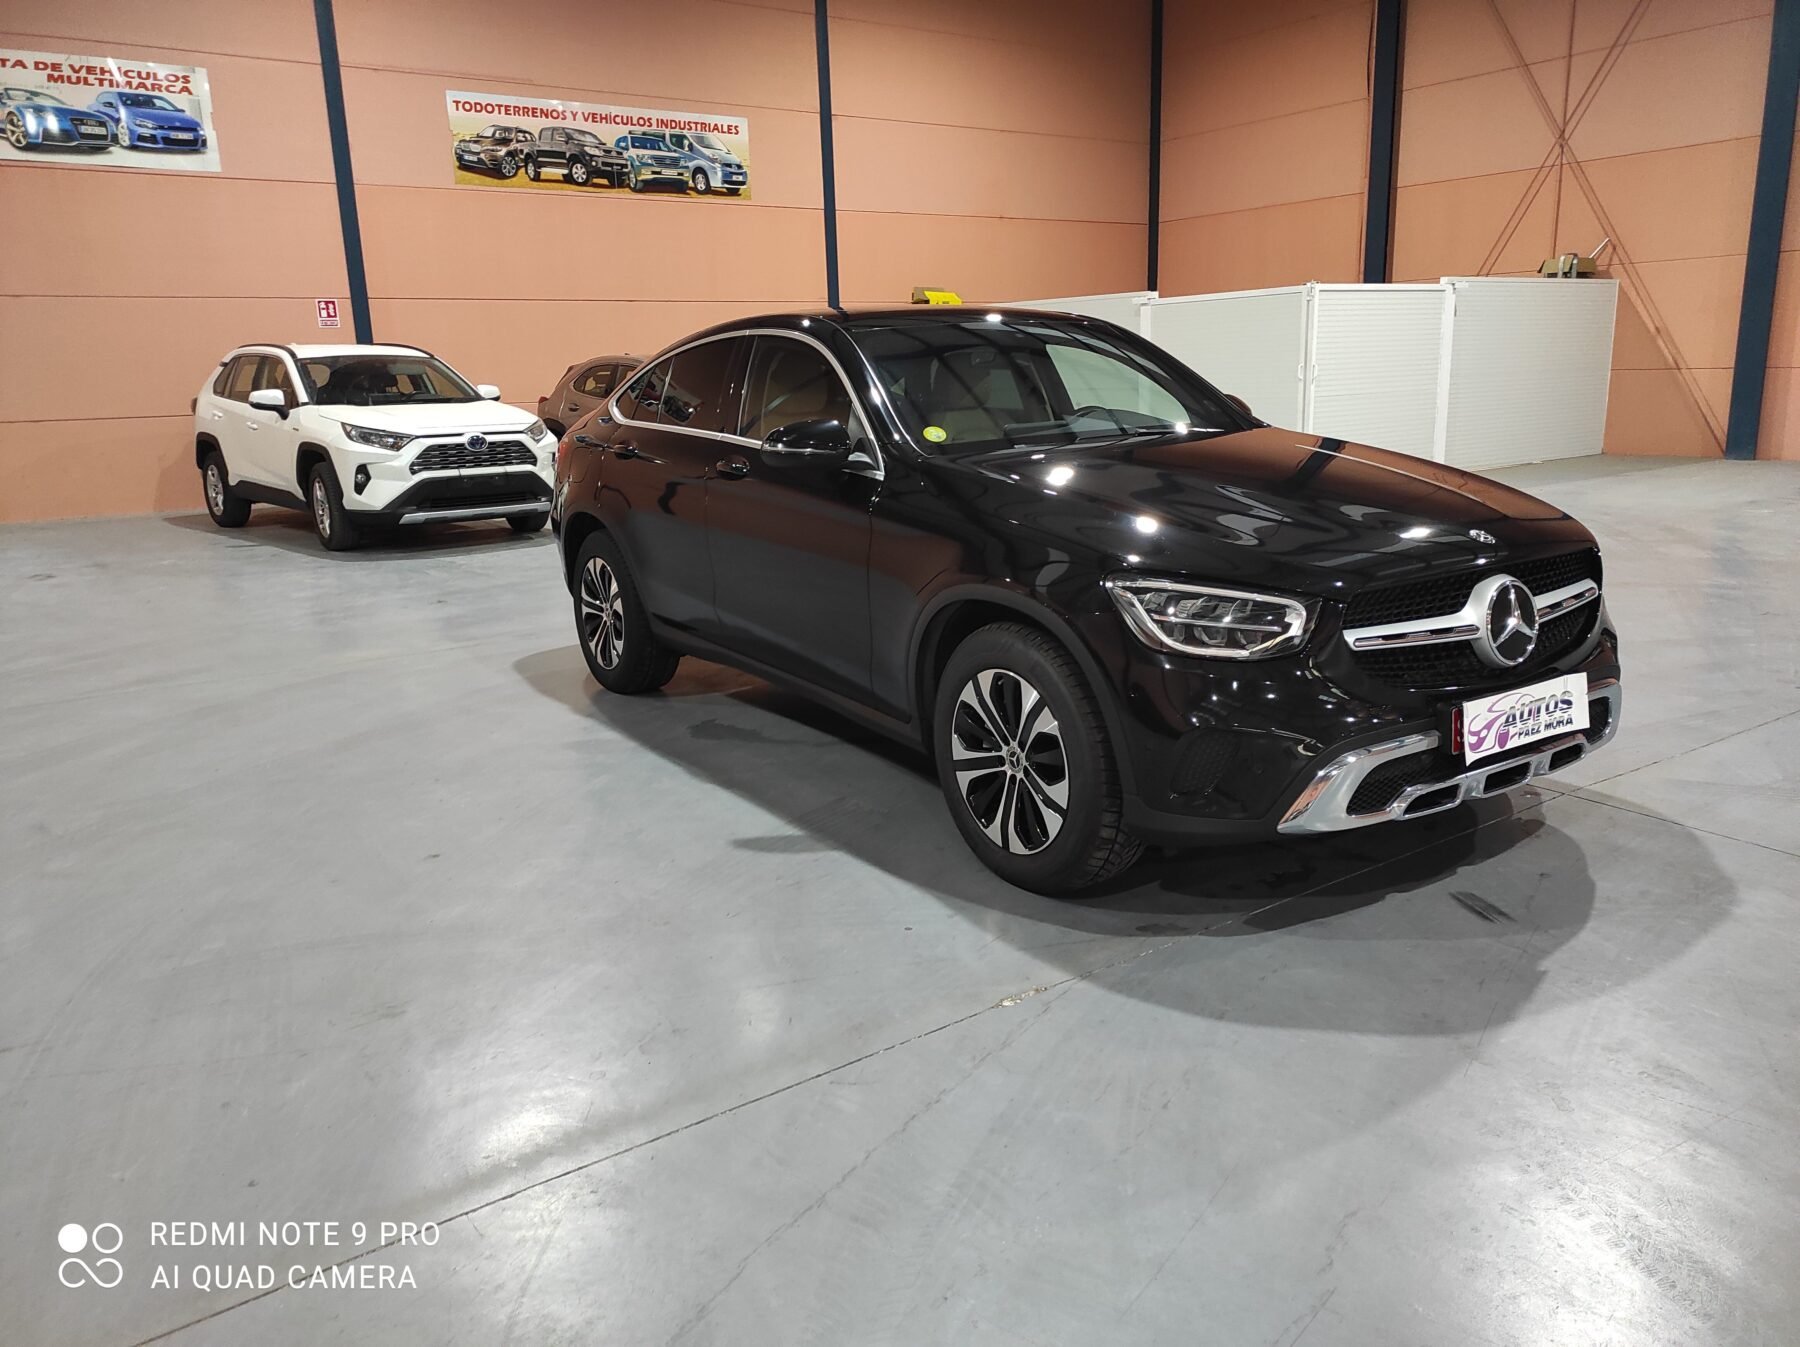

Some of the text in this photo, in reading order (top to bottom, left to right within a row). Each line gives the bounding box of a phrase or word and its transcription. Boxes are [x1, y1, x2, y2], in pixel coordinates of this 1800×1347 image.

[33, 60, 63, 73] DE
[46, 73, 194, 96] MULTIMARCA
[452, 100, 740, 136] TODOTERRENOS Y VEHÍCULOS INDUSTRIALES
[1503, 690, 1573, 730] AUTOS
[1543, 714, 1574, 732] MORA
